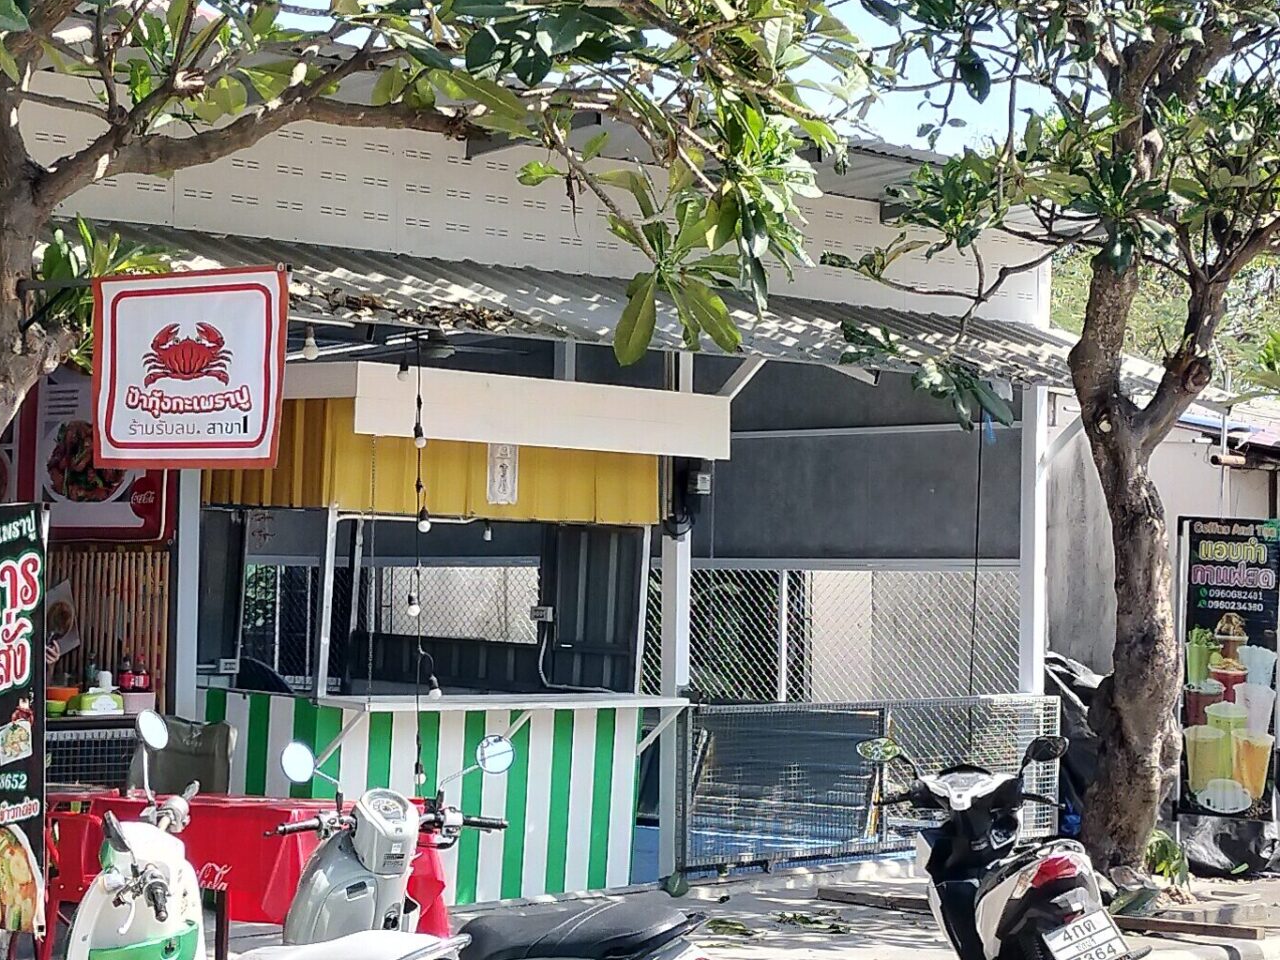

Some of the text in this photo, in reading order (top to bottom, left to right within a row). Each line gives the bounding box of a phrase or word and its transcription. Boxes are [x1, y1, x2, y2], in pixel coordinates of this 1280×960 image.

[125, 385, 253, 419] ป้ากุ้งกะเพราปู
[1191, 561, 1276, 590] กาแฟสด
